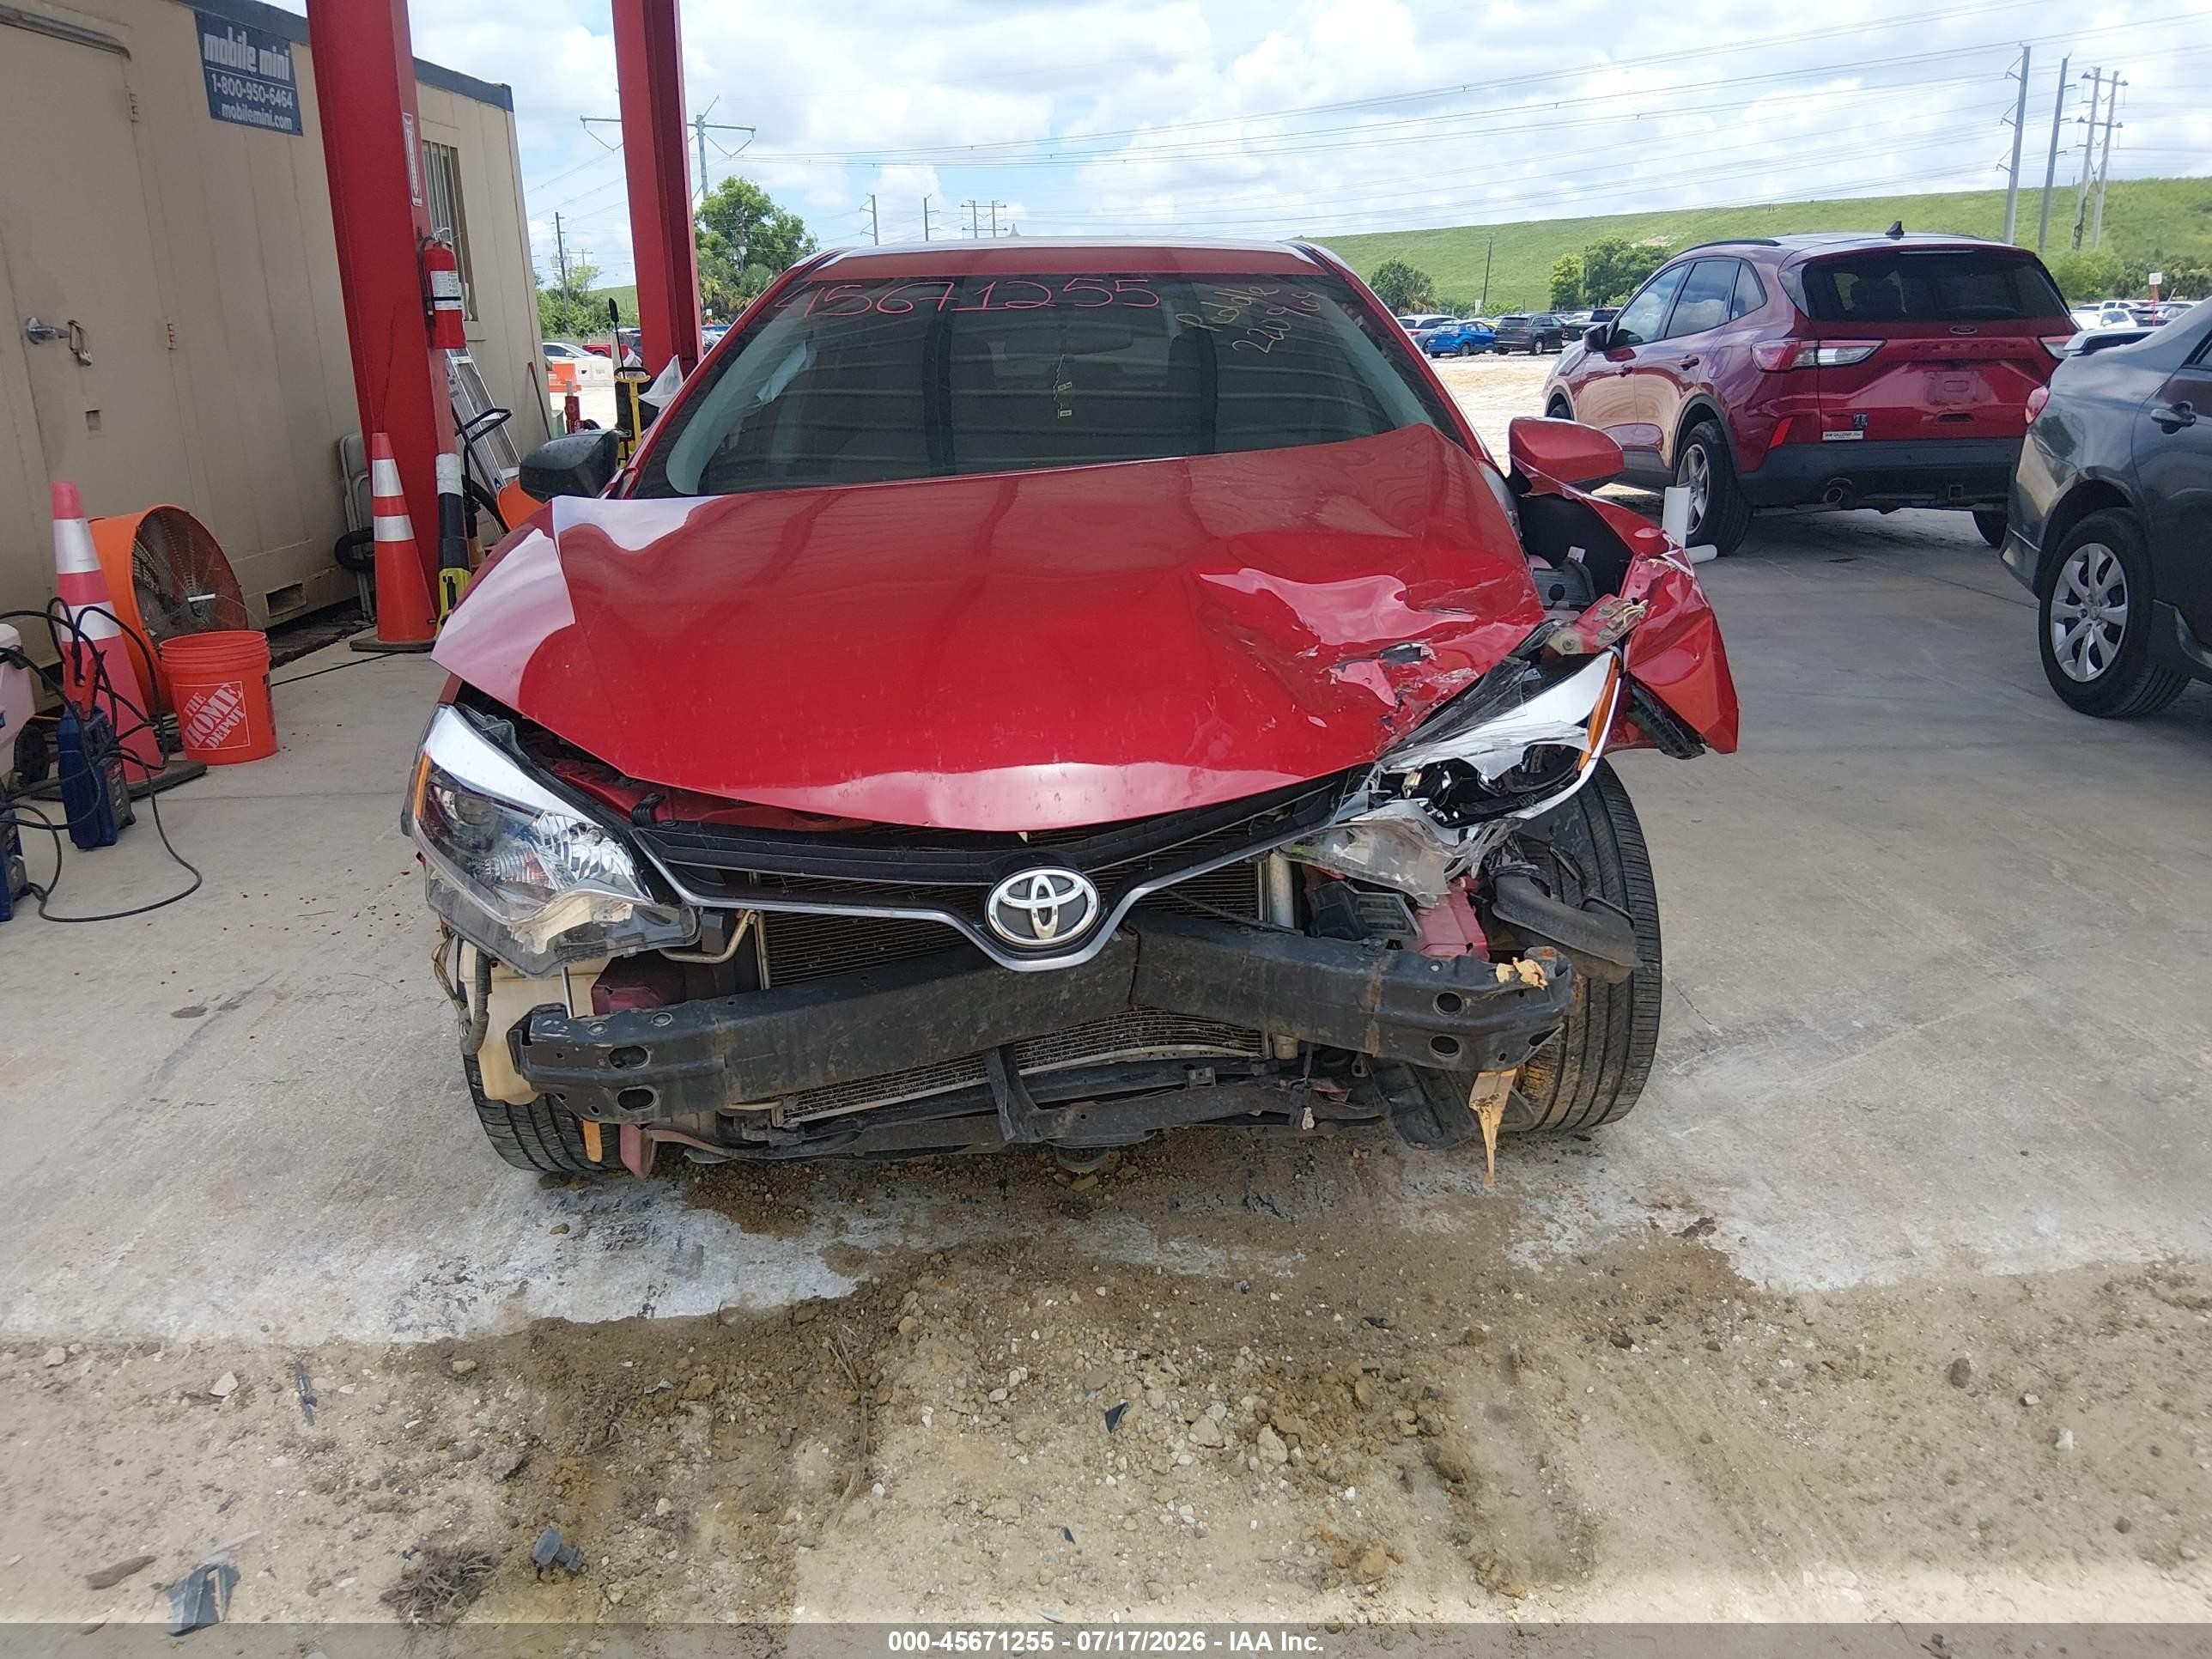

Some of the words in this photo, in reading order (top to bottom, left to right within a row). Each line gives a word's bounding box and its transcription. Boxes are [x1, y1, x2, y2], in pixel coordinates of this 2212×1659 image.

[204, 27, 257, 73] mobile
[259, 46, 290, 82] mini
[211, 73, 294, 110] 1-800-950-6464
[222, 102, 293, 131] mobilemini.com
[775, 277, 1160, 318] 45671255
[183, 691, 207, 718] THE
[184, 684, 243, 749] HOME
[204, 705, 247, 749] DEPOT
